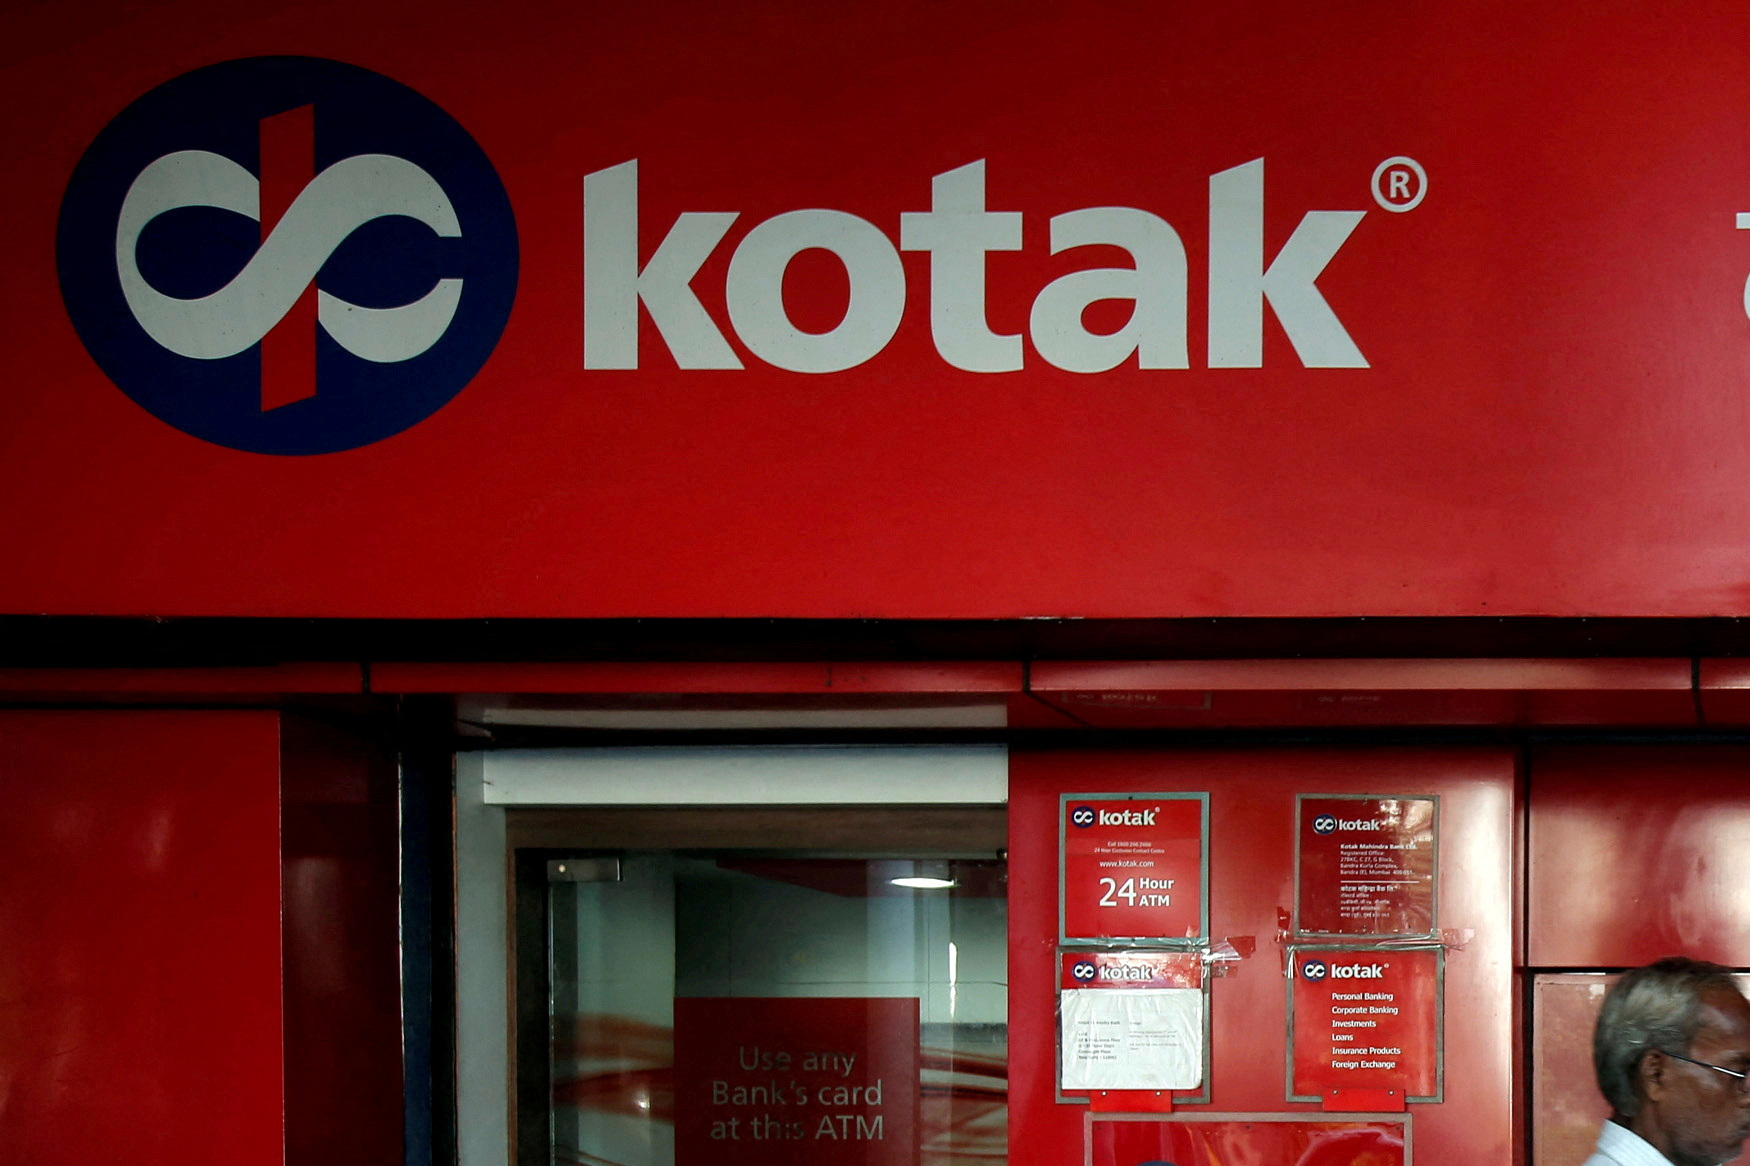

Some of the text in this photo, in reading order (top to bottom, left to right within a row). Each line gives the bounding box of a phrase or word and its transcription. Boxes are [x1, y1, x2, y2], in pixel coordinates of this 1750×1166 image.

[1099, 859, 1155, 867] www.kotak.com
[1099, 877, 1175, 907] 24 Hour
[1139, 894, 1170, 907] ATM
[1332, 992, 1394, 1001] Personal Banking
[1332, 1006, 1398, 1014] Corporate Banking
[1332, 1020, 1376, 1028] Investments
[739, 1046, 857, 1077] Use any
[1332, 1060, 1396, 1070] Foreign Exchange
[818, 1079, 883, 1106] card
[710, 1113, 884, 1140] at this ATM
